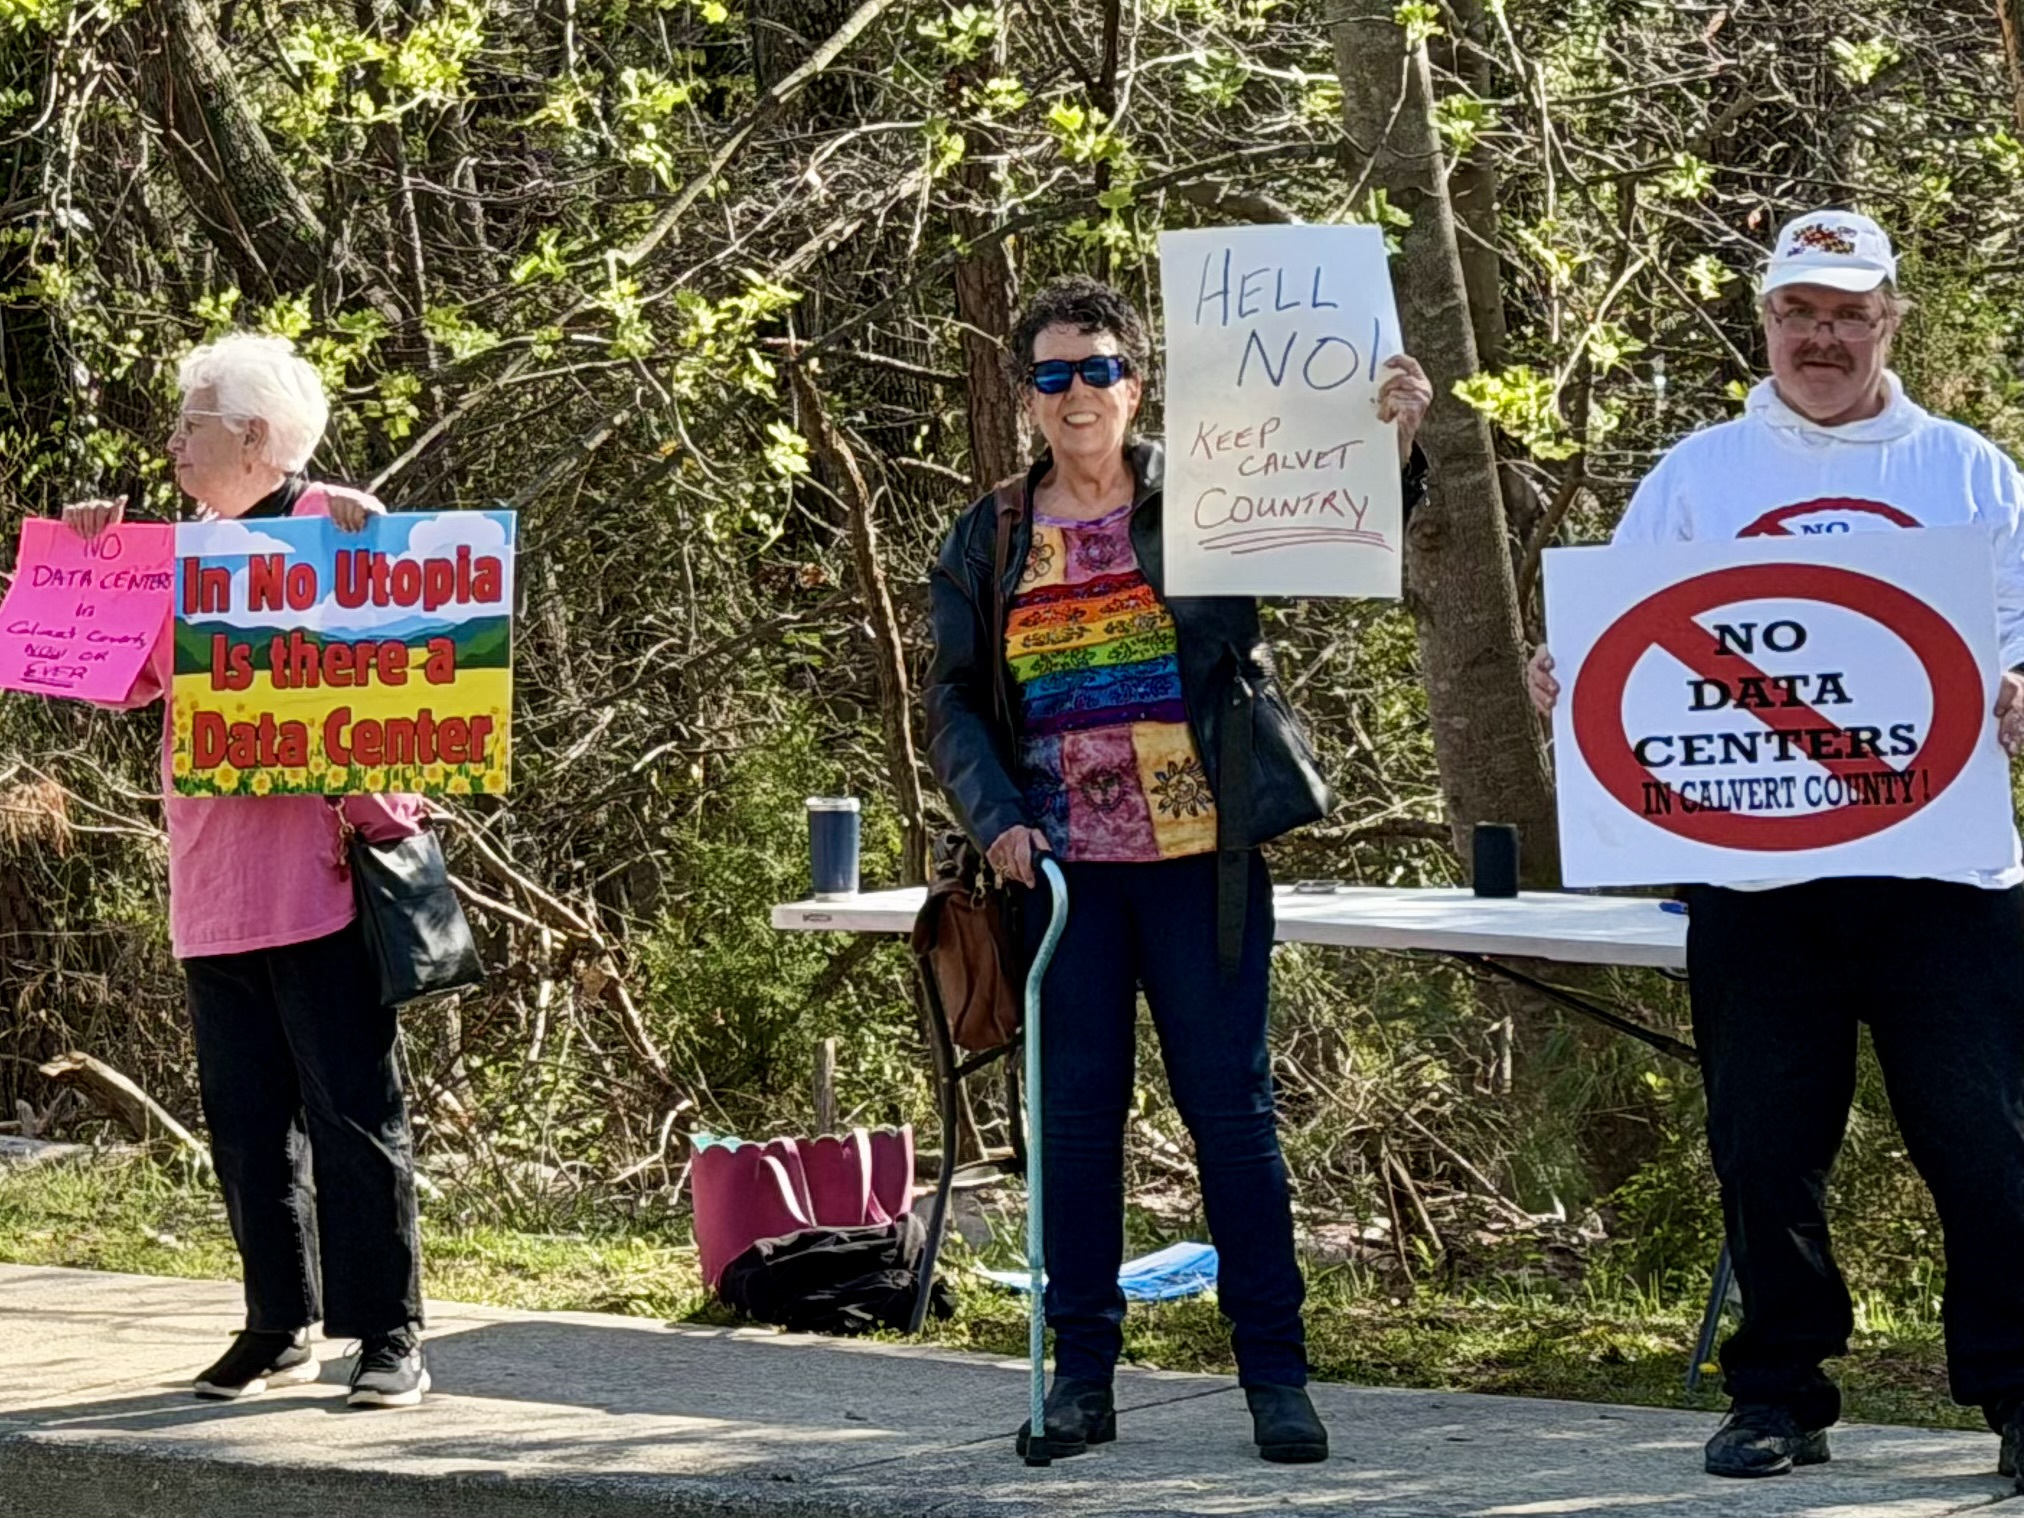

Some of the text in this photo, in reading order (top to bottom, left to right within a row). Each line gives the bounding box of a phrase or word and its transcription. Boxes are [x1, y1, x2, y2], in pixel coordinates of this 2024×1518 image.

[1196, 248, 1339, 326] HELL
[1190, 416, 1281, 460] KEEP
[1237, 440, 1364, 477] CALVET
[1194, 488, 1369, 531] COUNTRY
[32, 565, 92, 588] DATA
[182, 544, 503, 616] In No Utopia
[1713, 619, 1807, 656] NO
[210, 629, 457, 692] Is there a
[1686, 671, 1853, 712] DATA
[192, 705, 494, 770] Data Center
[1633, 723, 1918, 768] CENTERS
[1641, 780, 1673, 816] IN
[1679, 774, 1798, 814] CALVERT
